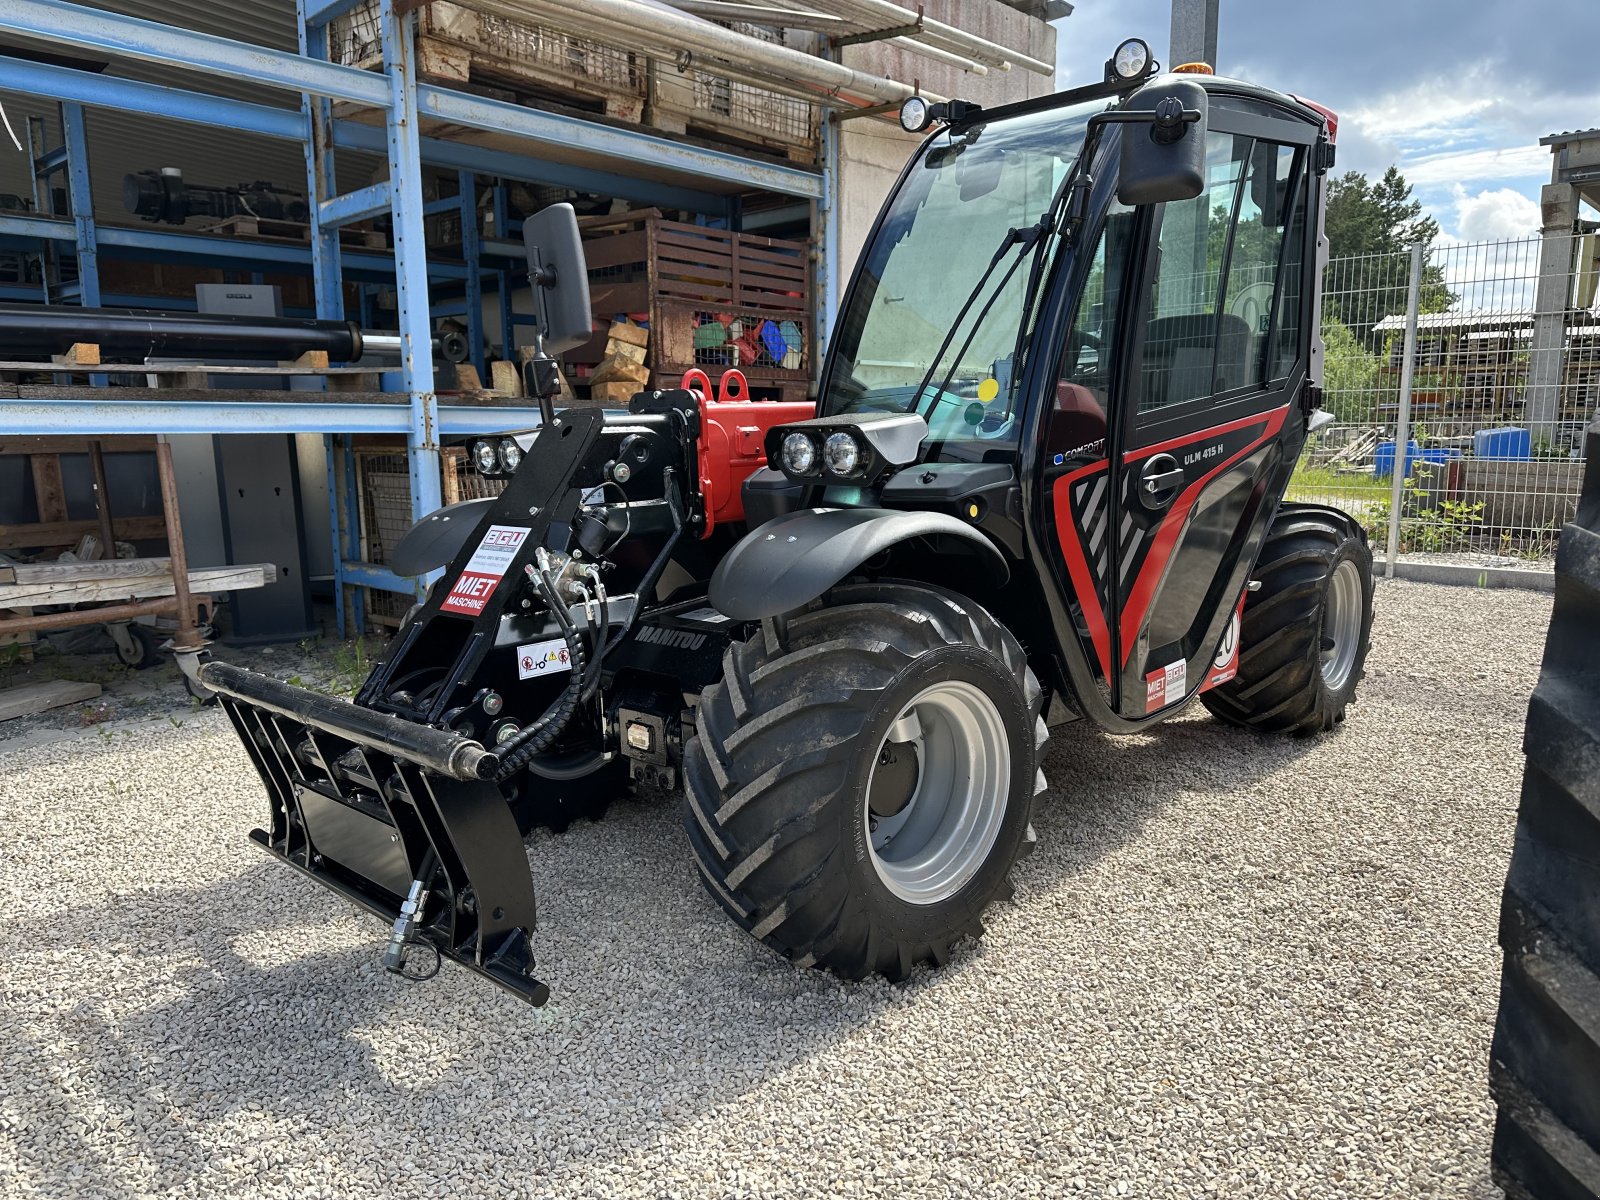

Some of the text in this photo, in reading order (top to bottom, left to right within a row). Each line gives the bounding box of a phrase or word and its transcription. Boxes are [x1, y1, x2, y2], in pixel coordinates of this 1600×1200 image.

[1064, 438, 1106, 459] COMFORT
[1184, 443, 1224, 466] ULM 415 H
[453, 575, 497, 597] MIET
[446, 595, 485, 610] MASCHINE
[634, 625, 708, 651] MANITOU
[1147, 676, 1166, 696] MIET
